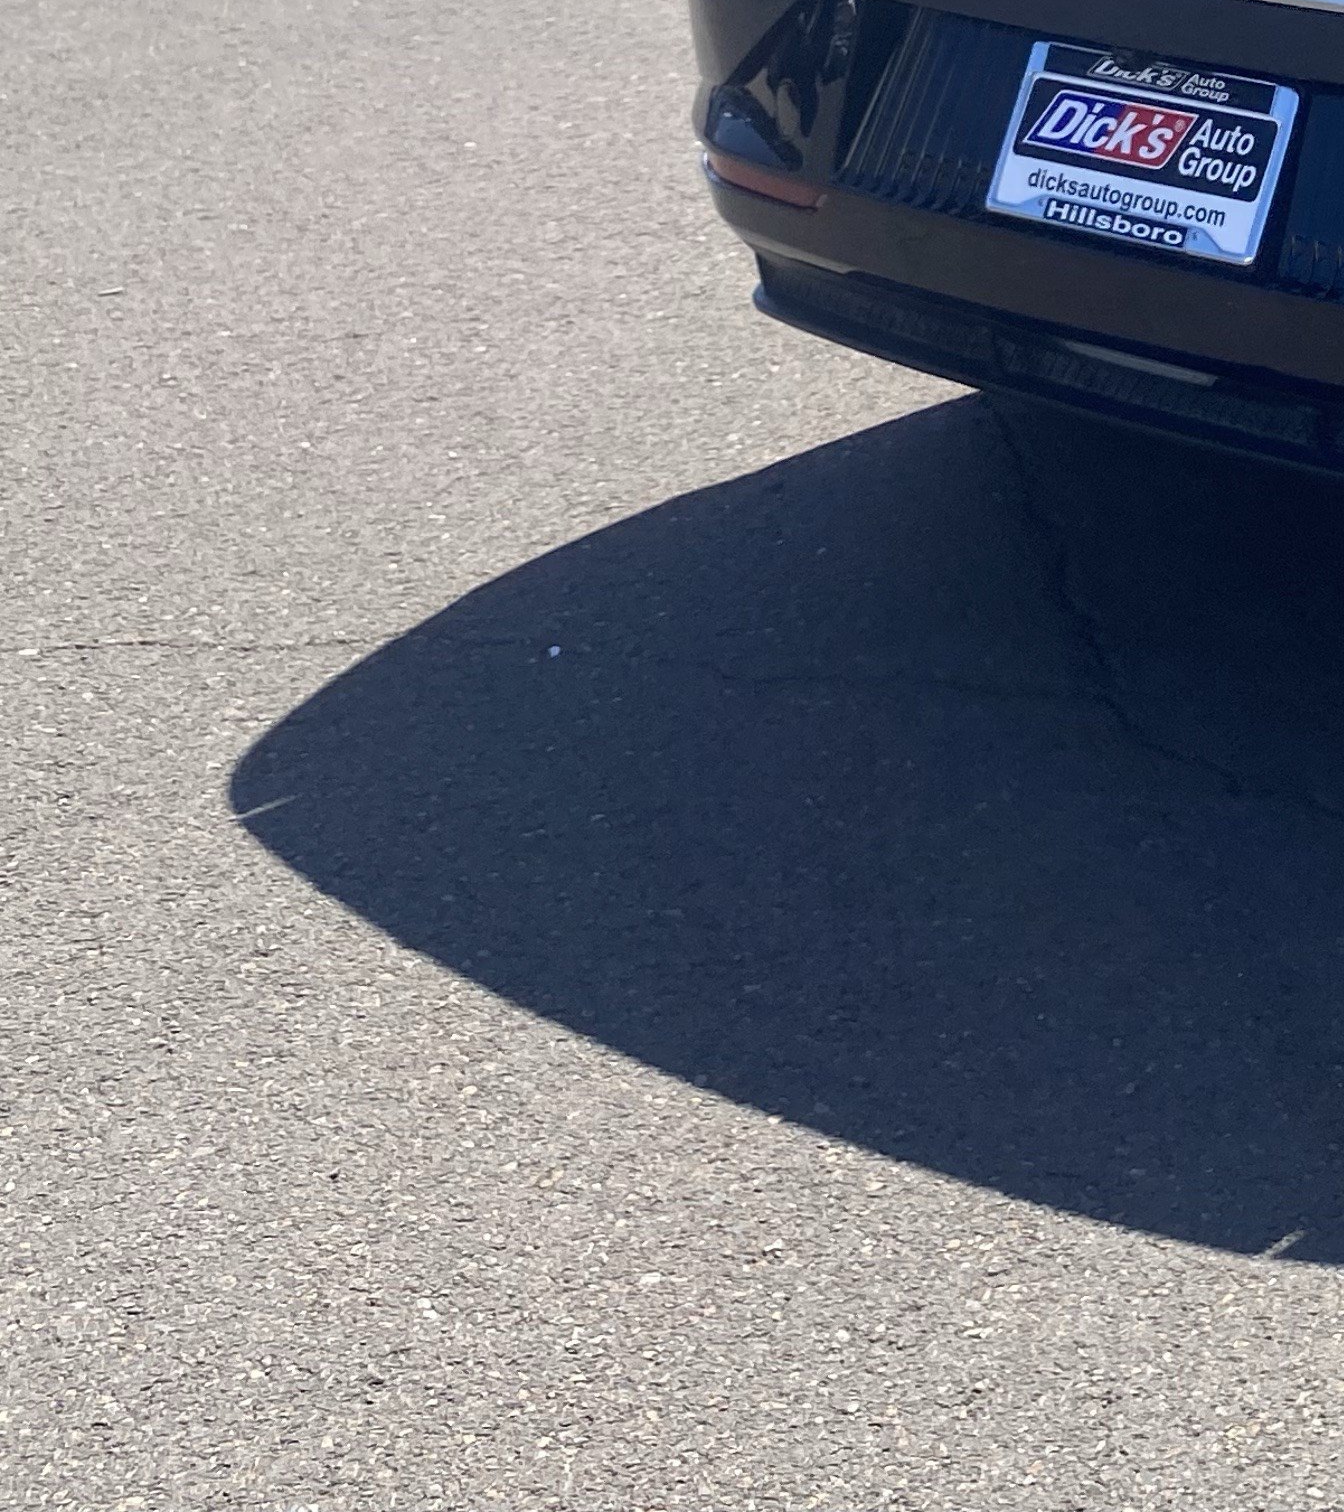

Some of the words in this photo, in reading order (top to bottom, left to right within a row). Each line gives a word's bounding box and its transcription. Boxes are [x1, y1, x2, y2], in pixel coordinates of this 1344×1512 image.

[1180, 82, 1230, 103] Group
[1189, 73, 1226, 90] Auto
[1038, 100, 1173, 159] Dick's
[1189, 118, 1256, 156] Auto
[1178, 147, 1257, 192] Group
[1027, 167, 1226, 227] dicksautogroup.com
[1047, 200, 1183, 245] Hillsboro
